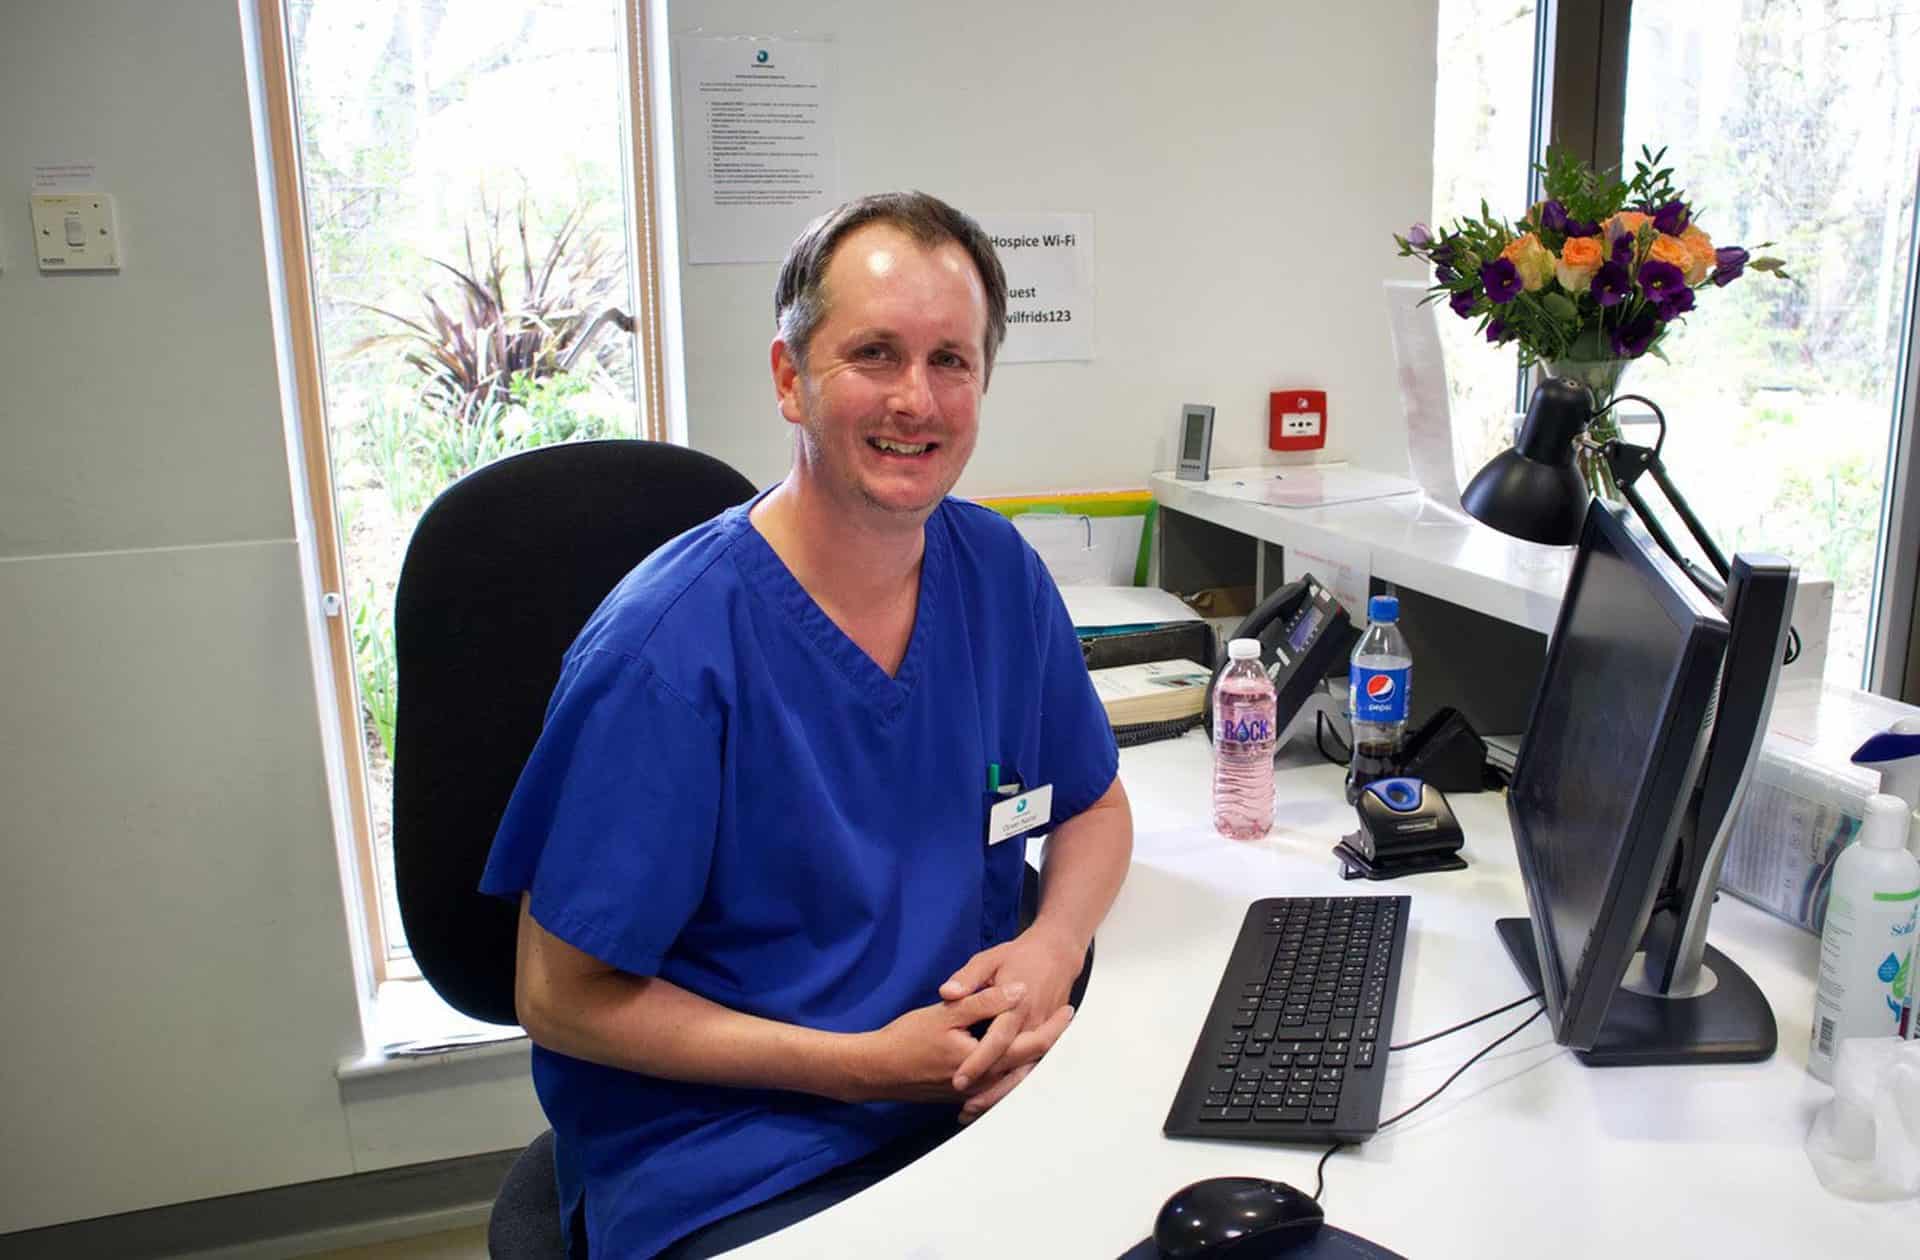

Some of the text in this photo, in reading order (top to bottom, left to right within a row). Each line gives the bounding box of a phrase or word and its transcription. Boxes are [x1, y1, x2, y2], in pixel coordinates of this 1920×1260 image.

[990, 234, 1075, 250] Hospice Wi-Fi
[1007, 287, 1036, 298] uest
